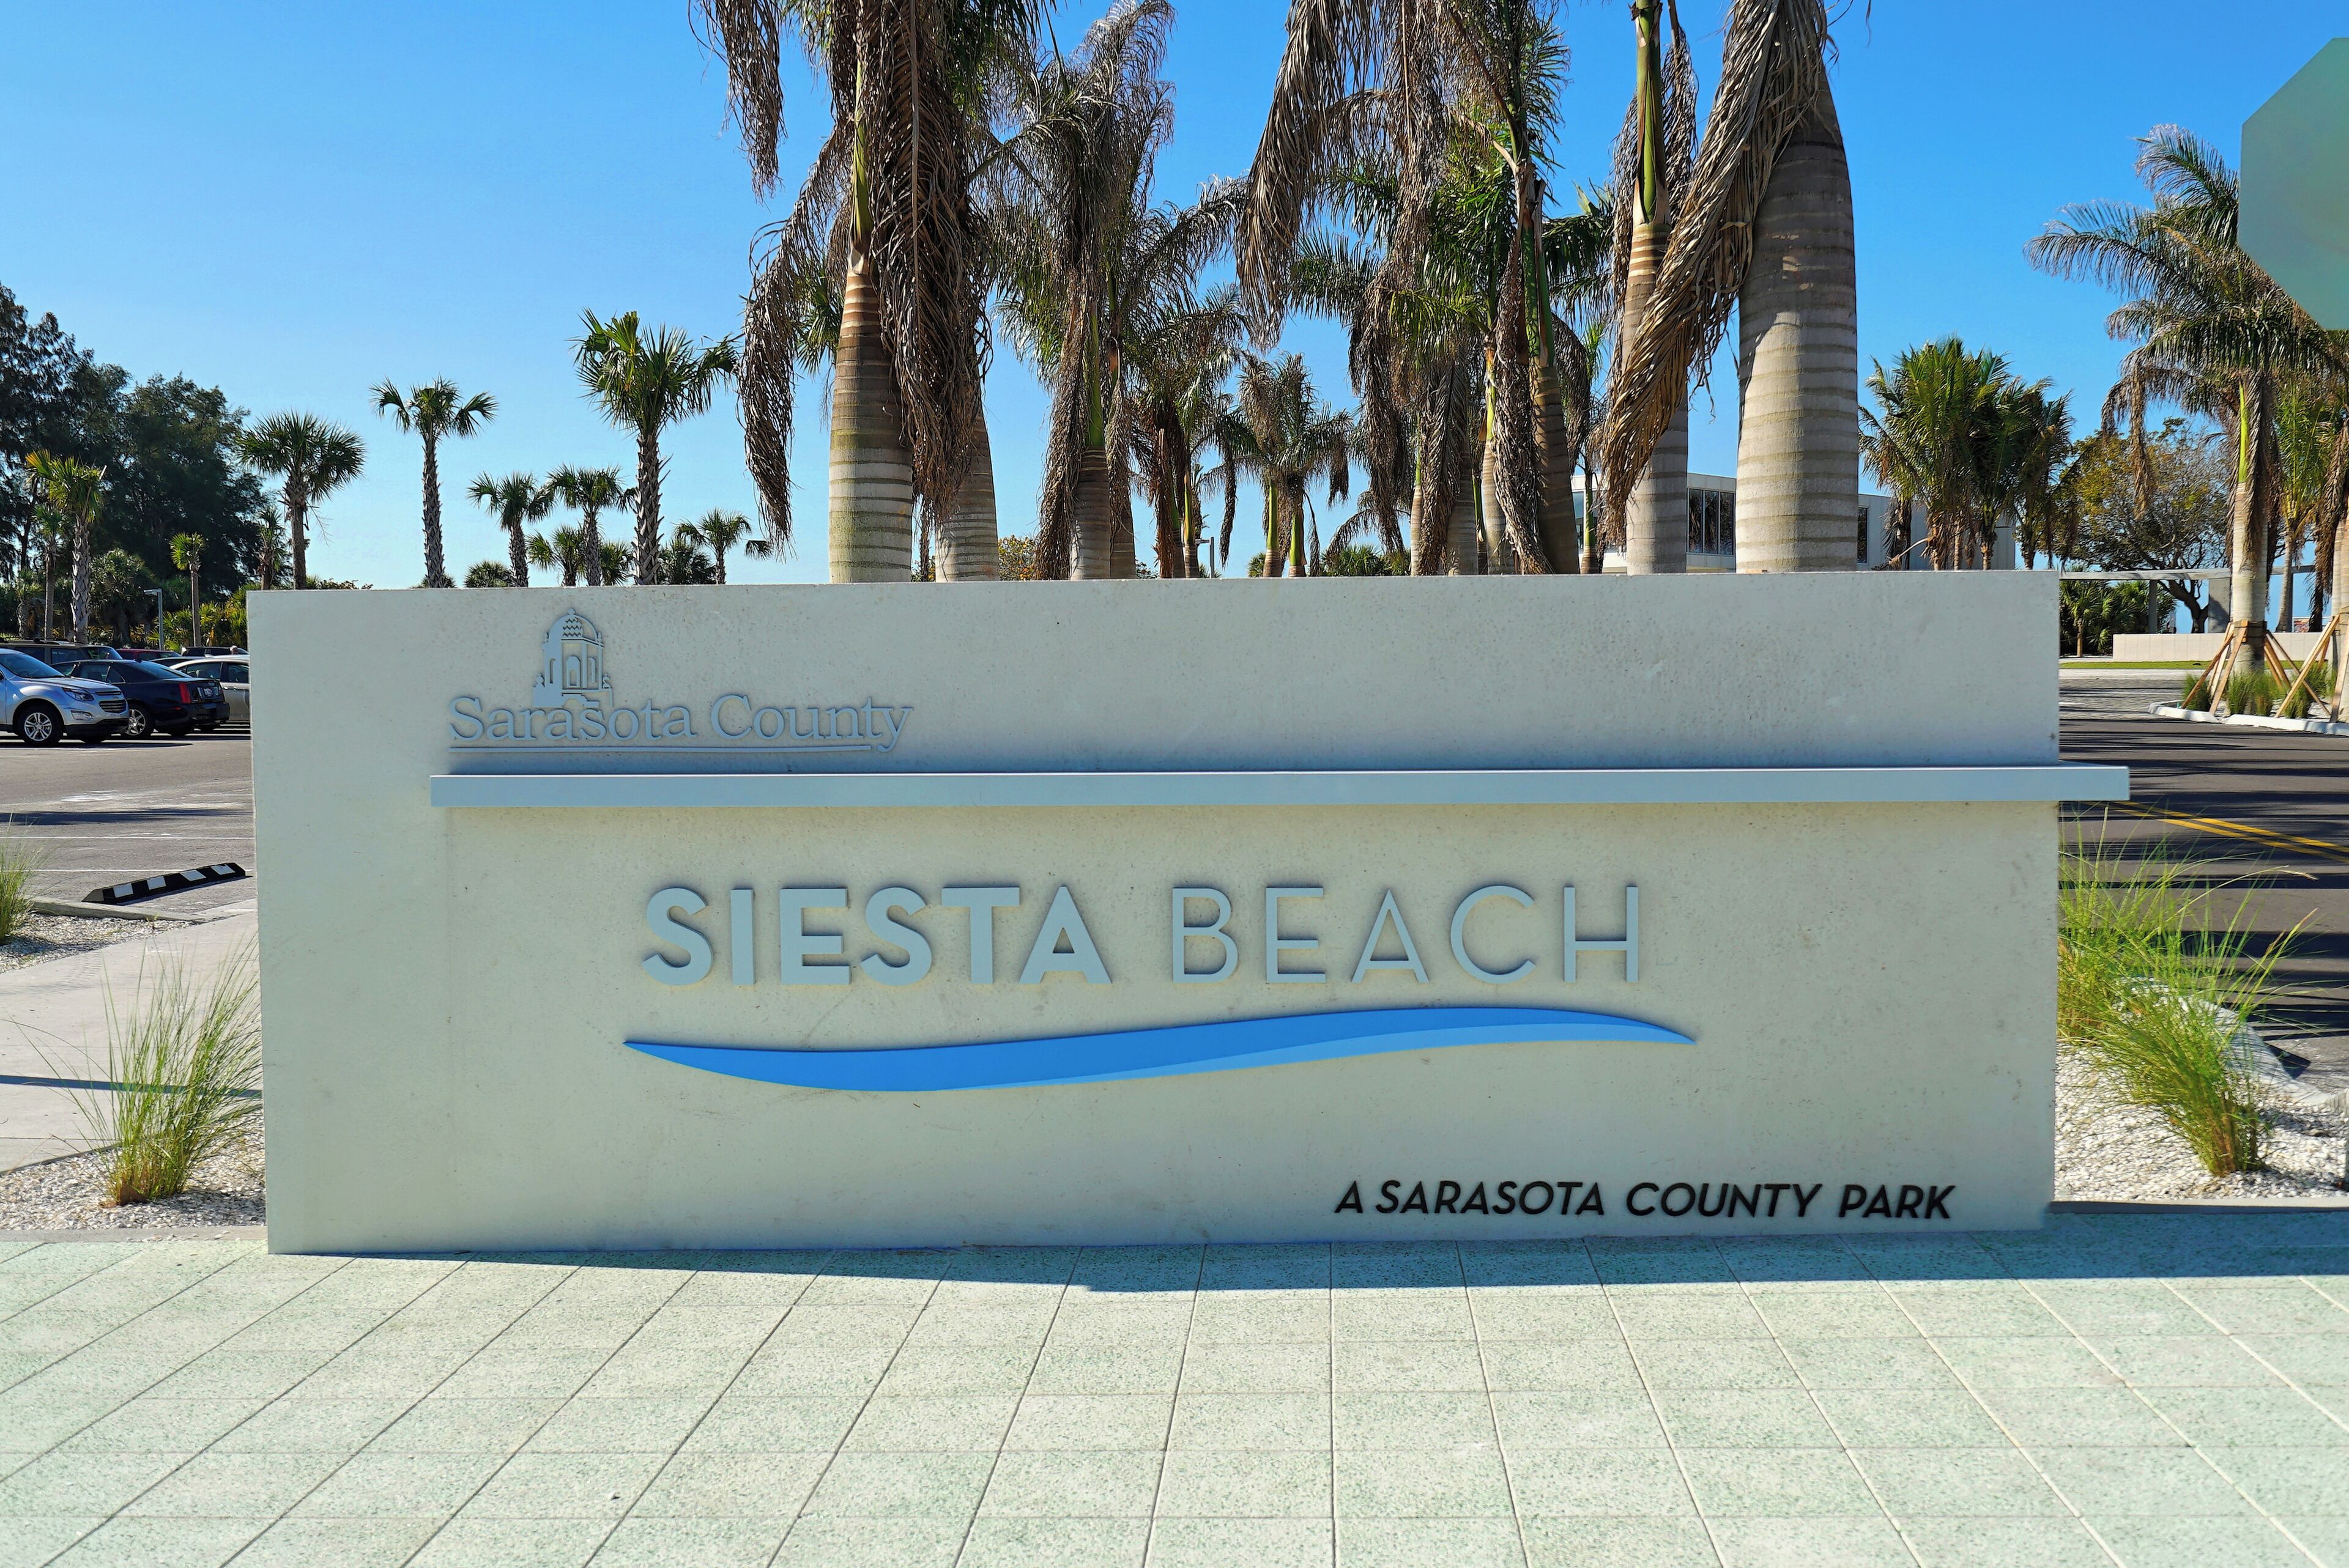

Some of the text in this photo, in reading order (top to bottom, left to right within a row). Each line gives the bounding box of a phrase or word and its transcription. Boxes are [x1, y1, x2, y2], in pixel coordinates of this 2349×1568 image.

[448, 693, 913, 753] Sarasota County
[642, 885, 1641, 986] SIESTA BEACH
[1334, 1180, 1956, 1219] A SARASOTA COUNTY PARK
